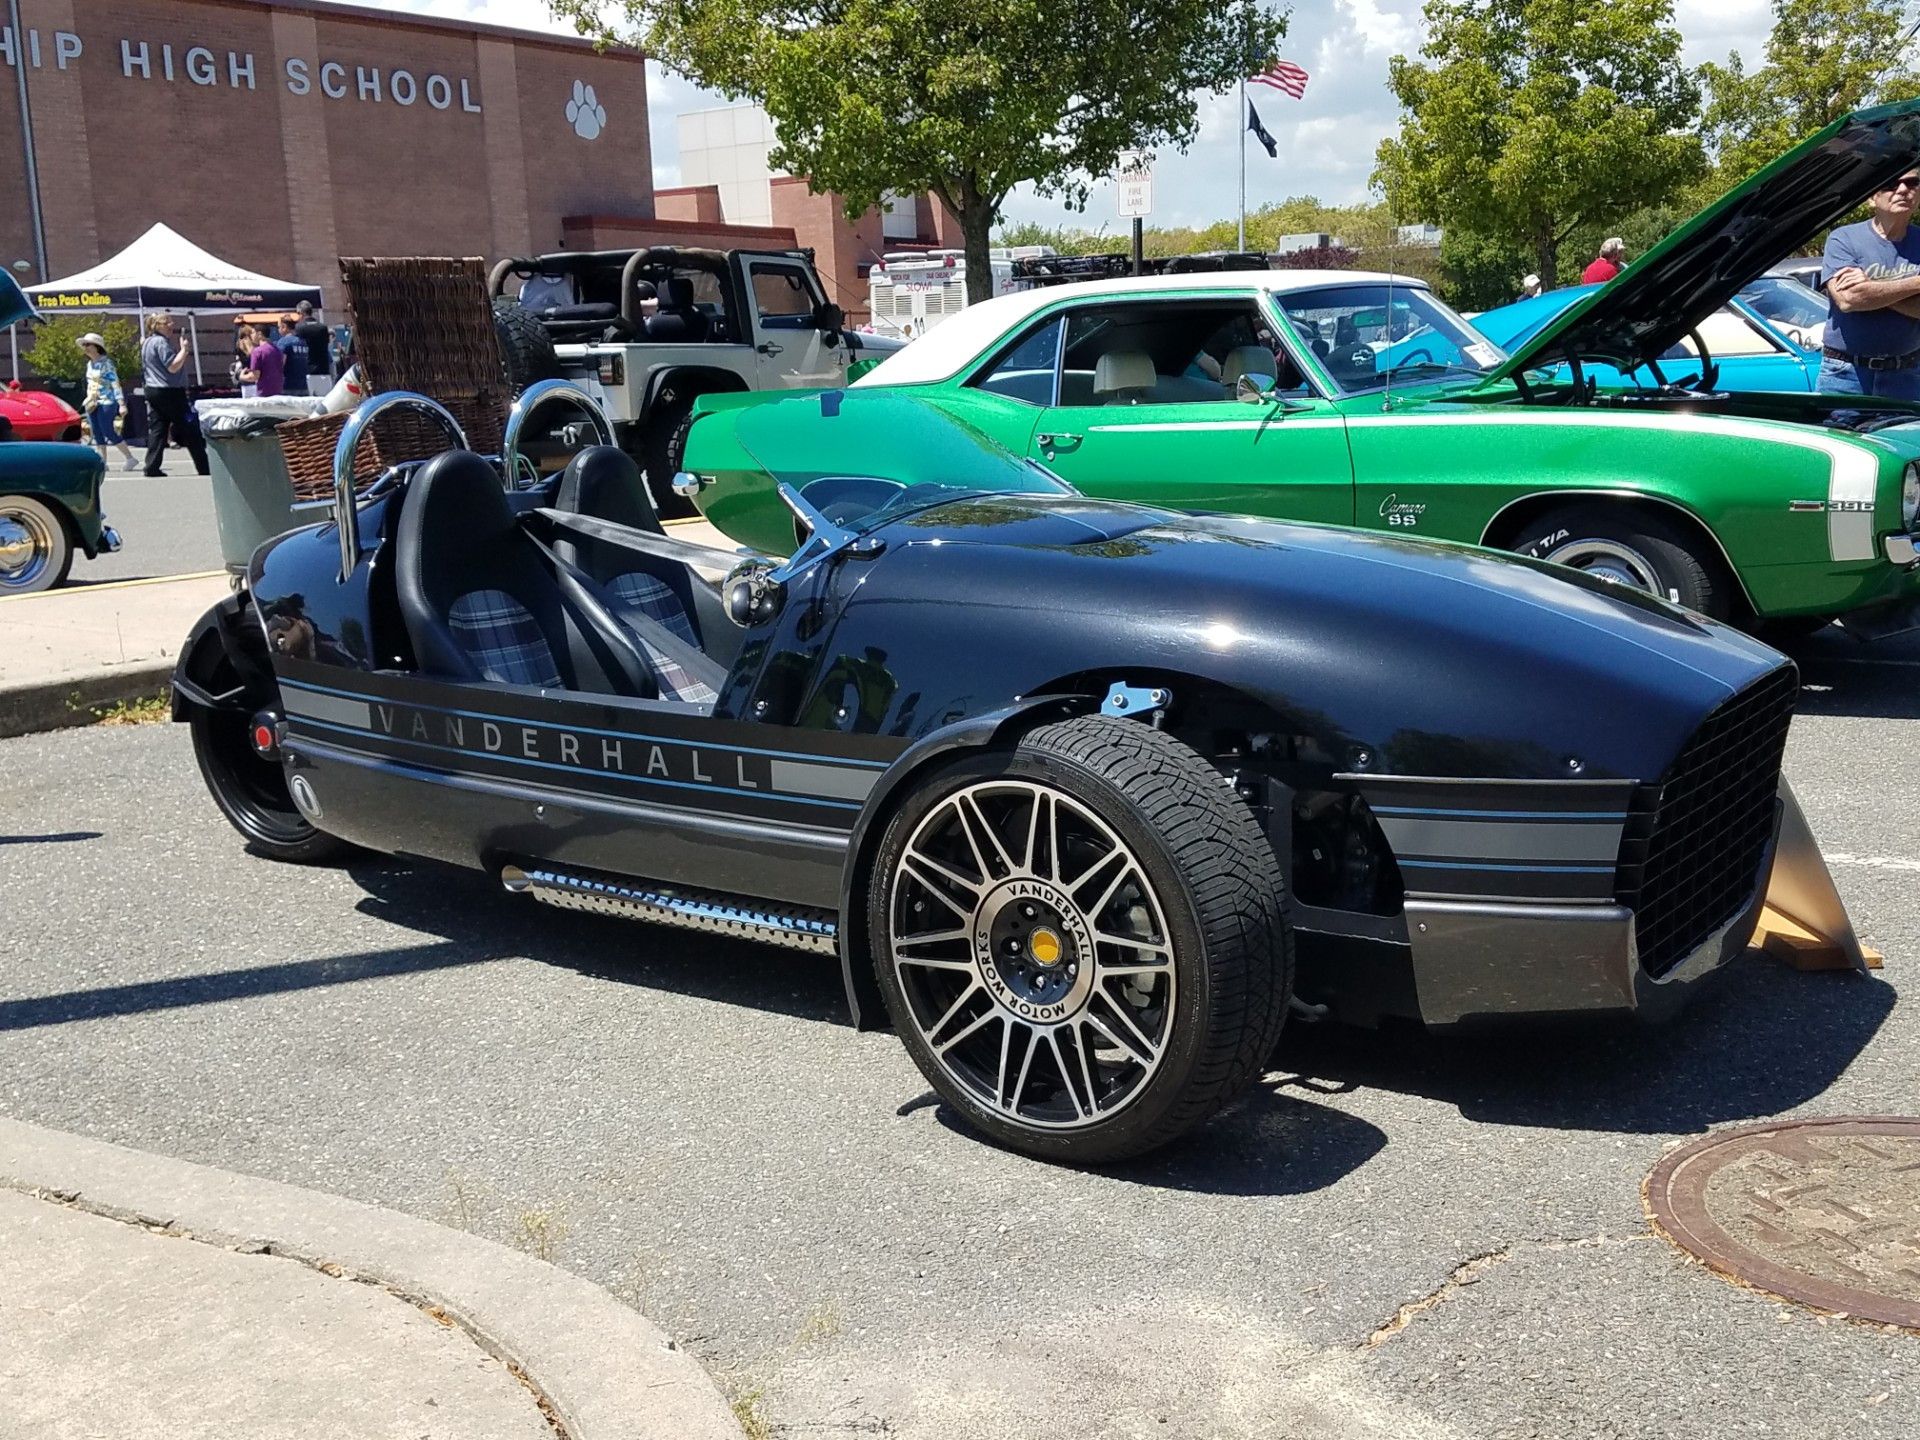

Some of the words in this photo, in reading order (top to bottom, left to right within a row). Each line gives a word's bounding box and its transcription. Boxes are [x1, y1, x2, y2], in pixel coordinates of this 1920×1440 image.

[120, 39, 256, 89] HIGH
[285, 57, 482, 113] SCHOOL
[1120, 173, 1151, 183] PARKING
[1127, 197, 1143, 207] LANE
[906, 281, 933, 292] SLOW!
[58, 293, 80, 306] Pass
[80, 291, 111, 306] Online
[1379, 493, 1426, 517] Camaro
[1829, 501, 1875, 512] 396
[1388, 513, 1417, 526] SS
[1539, 528, 1570, 549] T/A
[379, 705, 758, 790] VANDERHALL
[1006, 883, 1091, 961] VANDERHALL
[978, 930, 1006, 996] WORKS
[1009, 995, 1066, 1019] MOTOR
